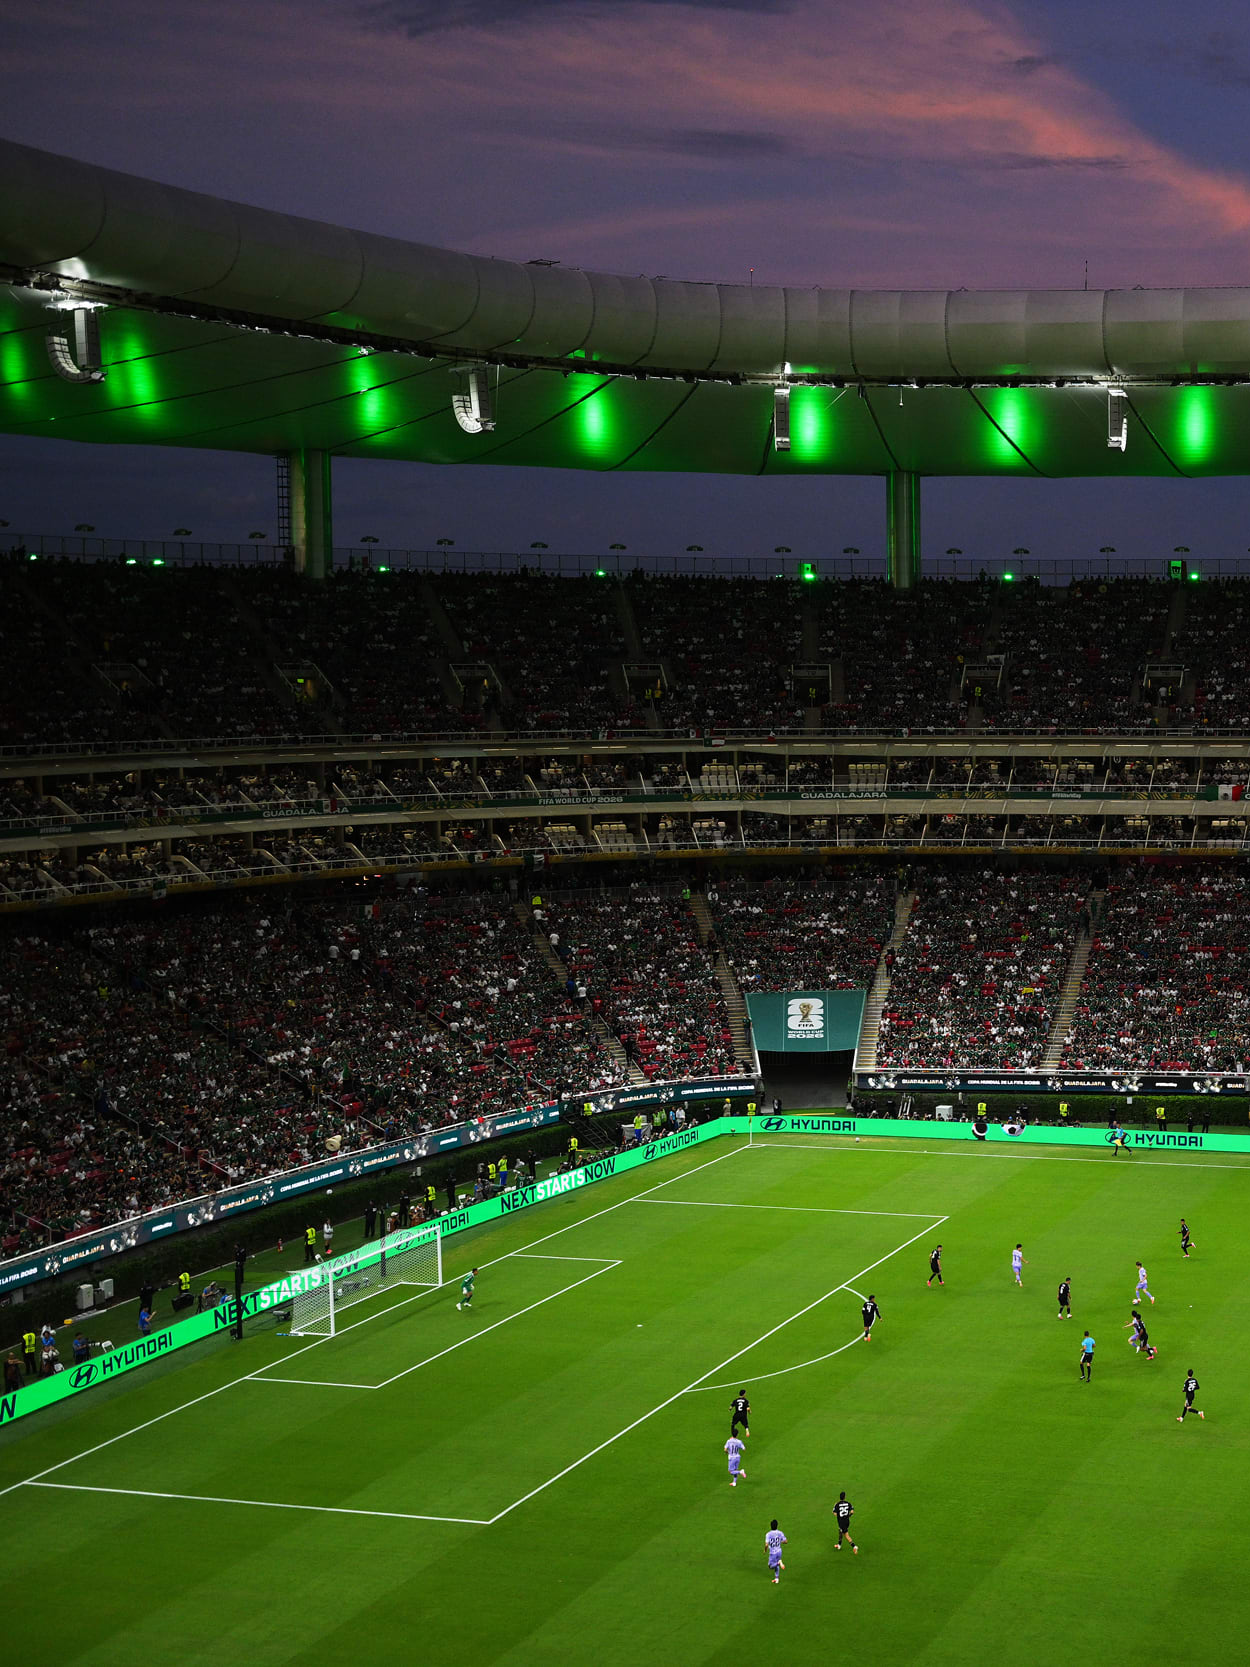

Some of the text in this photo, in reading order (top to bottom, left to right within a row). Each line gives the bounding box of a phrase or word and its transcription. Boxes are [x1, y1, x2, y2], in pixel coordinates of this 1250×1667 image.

[263, 806, 348, 818] GUADALARA
[792, 1119, 856, 1132] HYUNDAI
[660, 1130, 699, 1153] HYUNDAI
[1135, 1133, 1203, 1148] HYUNDAI
[102, 1332, 172, 1375] HYUNDAI
[738, 1402, 742, 1411] 2
[731, 1445, 739, 1454] 10
[839, 1507, 849, 1517] 25
